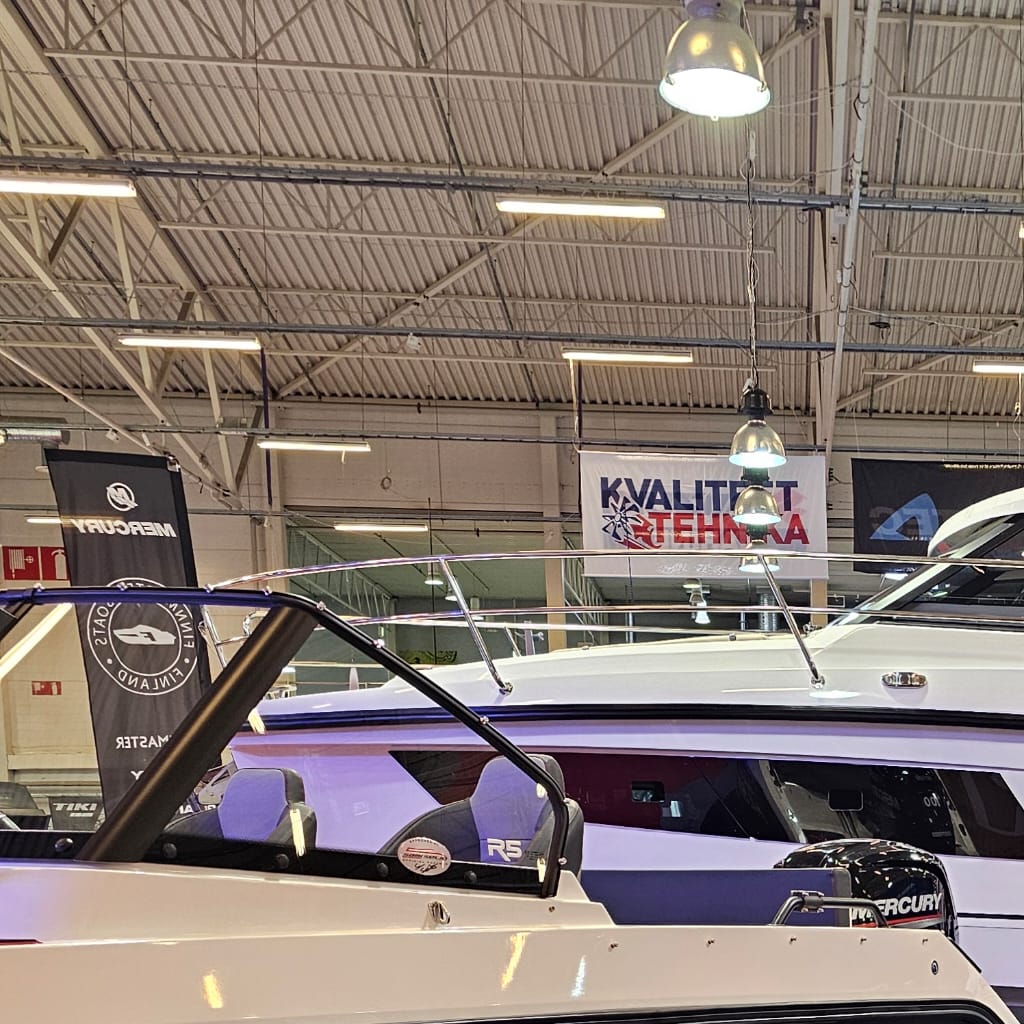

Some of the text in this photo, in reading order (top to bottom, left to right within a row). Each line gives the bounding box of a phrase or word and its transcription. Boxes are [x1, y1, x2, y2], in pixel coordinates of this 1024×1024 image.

[600, 477, 799, 512] KVALITET
[52, 802, 98, 812] TIKI
[486, 837, 523, 862] R5
